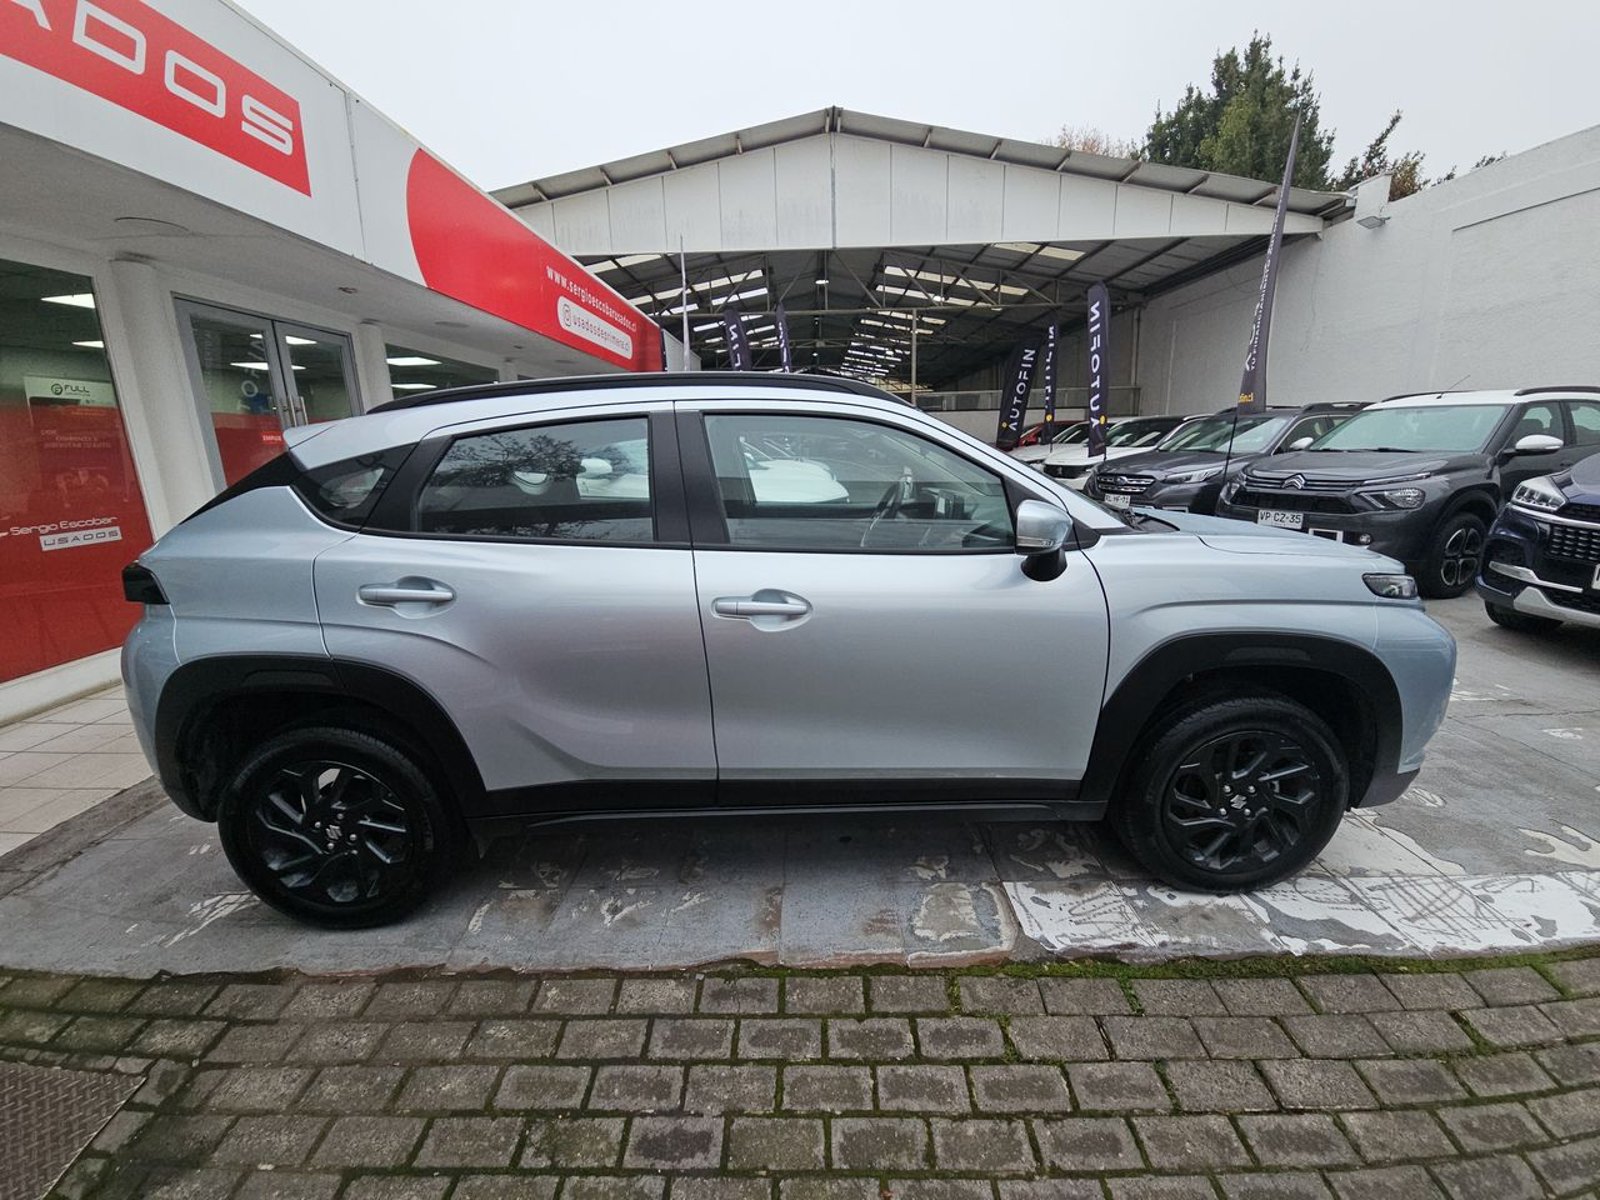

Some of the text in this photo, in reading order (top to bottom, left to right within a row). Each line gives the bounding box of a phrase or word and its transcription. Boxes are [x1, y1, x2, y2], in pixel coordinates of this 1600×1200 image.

[1008, 349, 1036, 431] AUTOFIN
[59, 516, 118, 529] Escobar
[43, 530, 119, 546] USADOS
